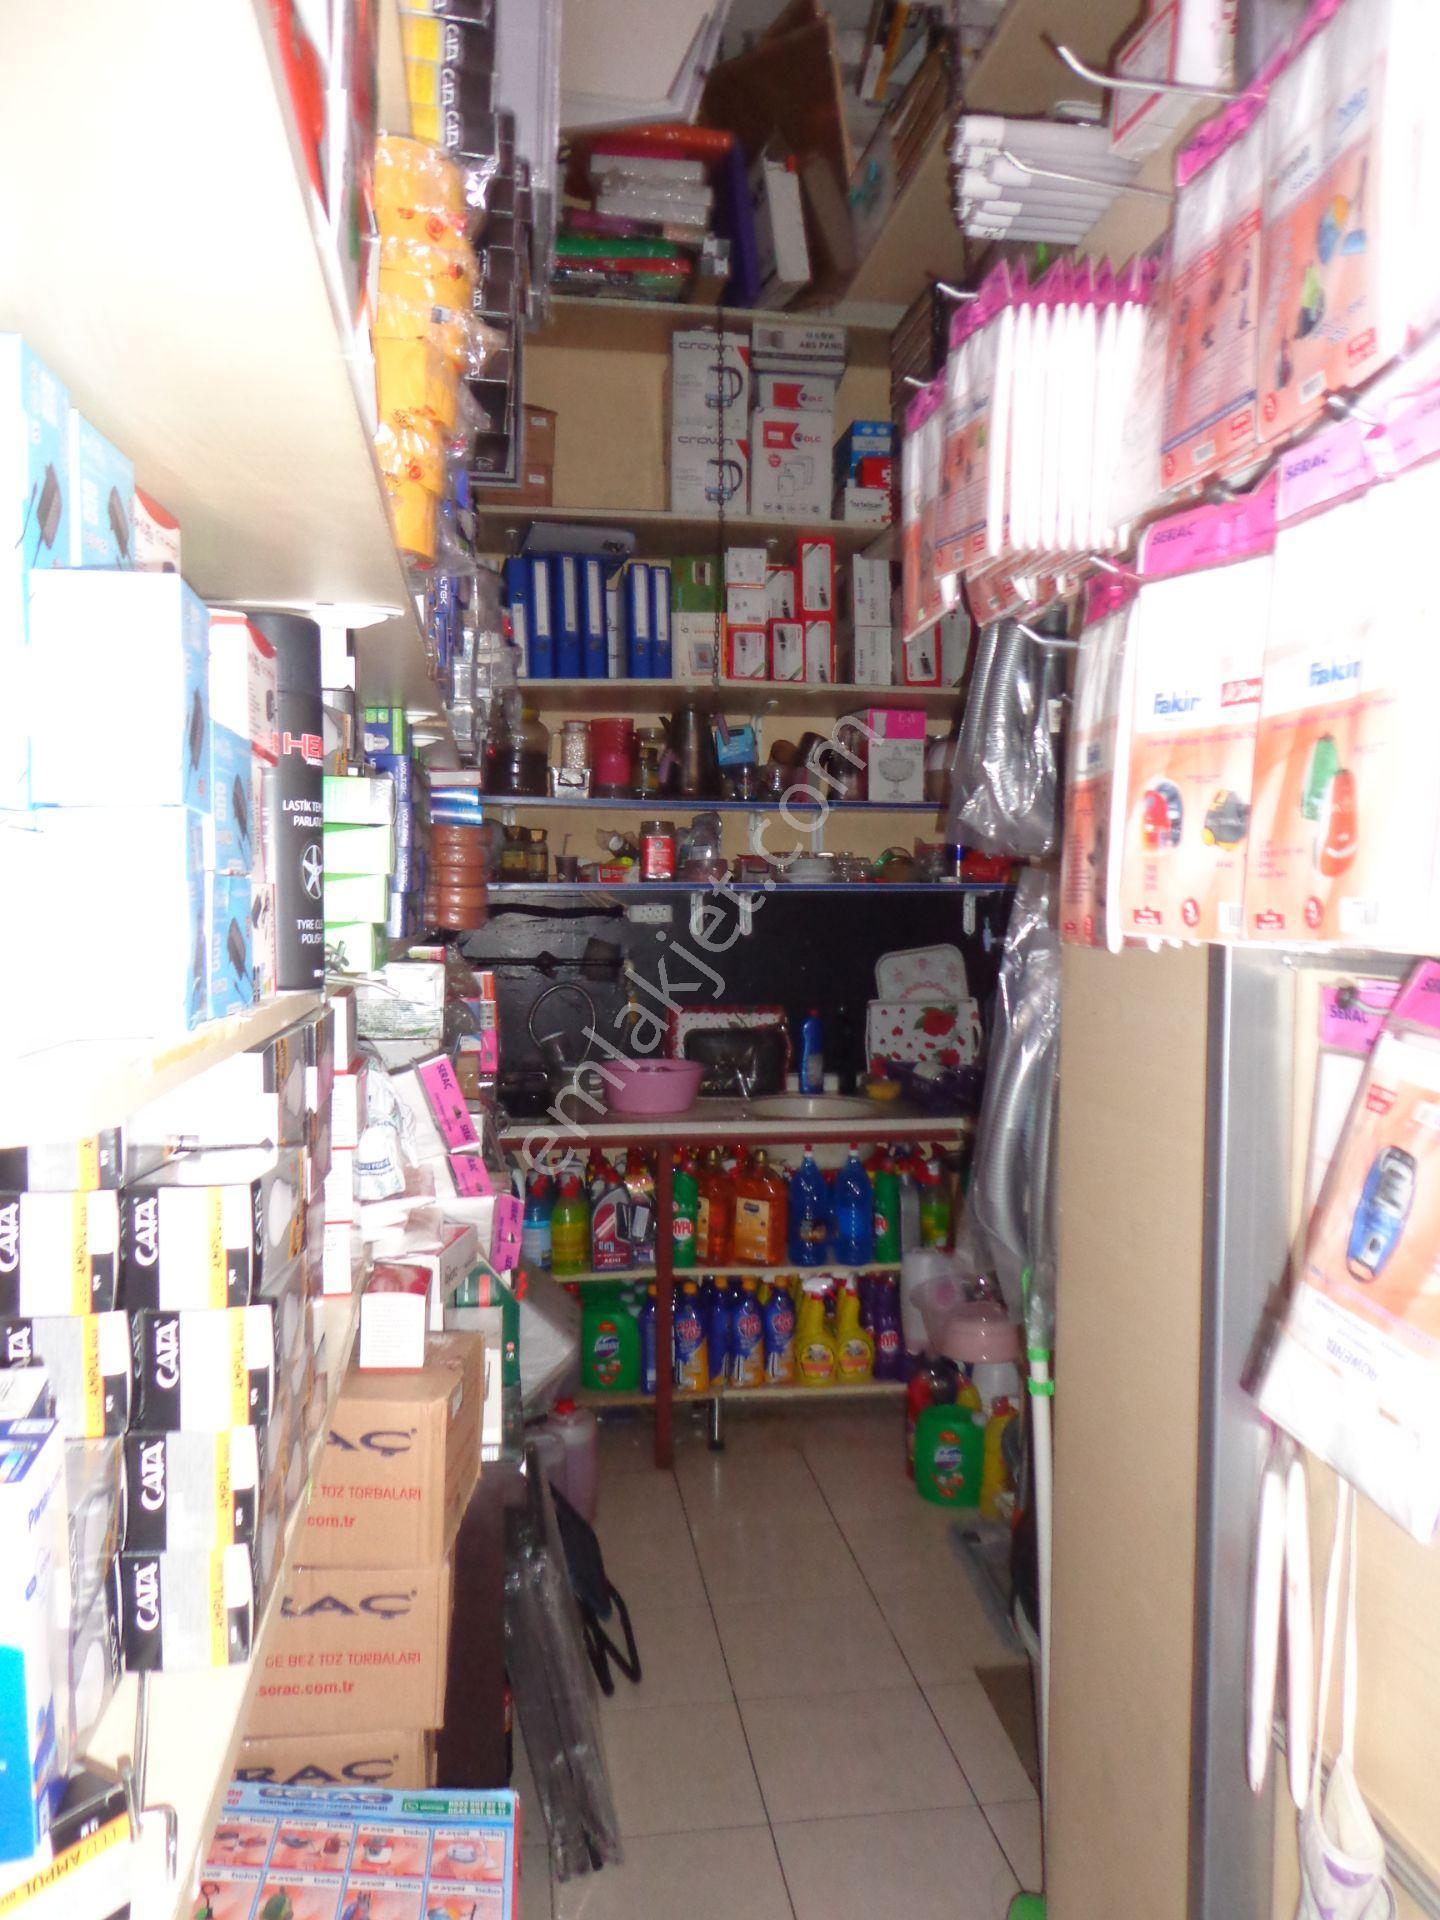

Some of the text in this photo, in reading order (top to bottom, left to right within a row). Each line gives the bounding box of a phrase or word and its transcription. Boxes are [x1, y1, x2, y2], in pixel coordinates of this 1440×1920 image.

[1309, 660, 1361, 687] Fakir
[1153, 692, 1201, 715] Fakir
[297, 919, 315, 930] TYRE
[0, 1202, 19, 1273] CATA
[134, 1197, 158, 1267] CATA
[155, 1319, 179, 1389] CATA
[140, 1439, 165, 1511] CATA
[321, 1486, 421, 1500] TOZ TORBALARI
[307, 1513, 355, 1529] com.tr
[135, 1561, 159, 1632] CATA
[288, 1653, 314, 1668] BEZ
[320, 1653, 343, 1666] TOZ
[349, 1651, 421, 1667] TORBALARI
